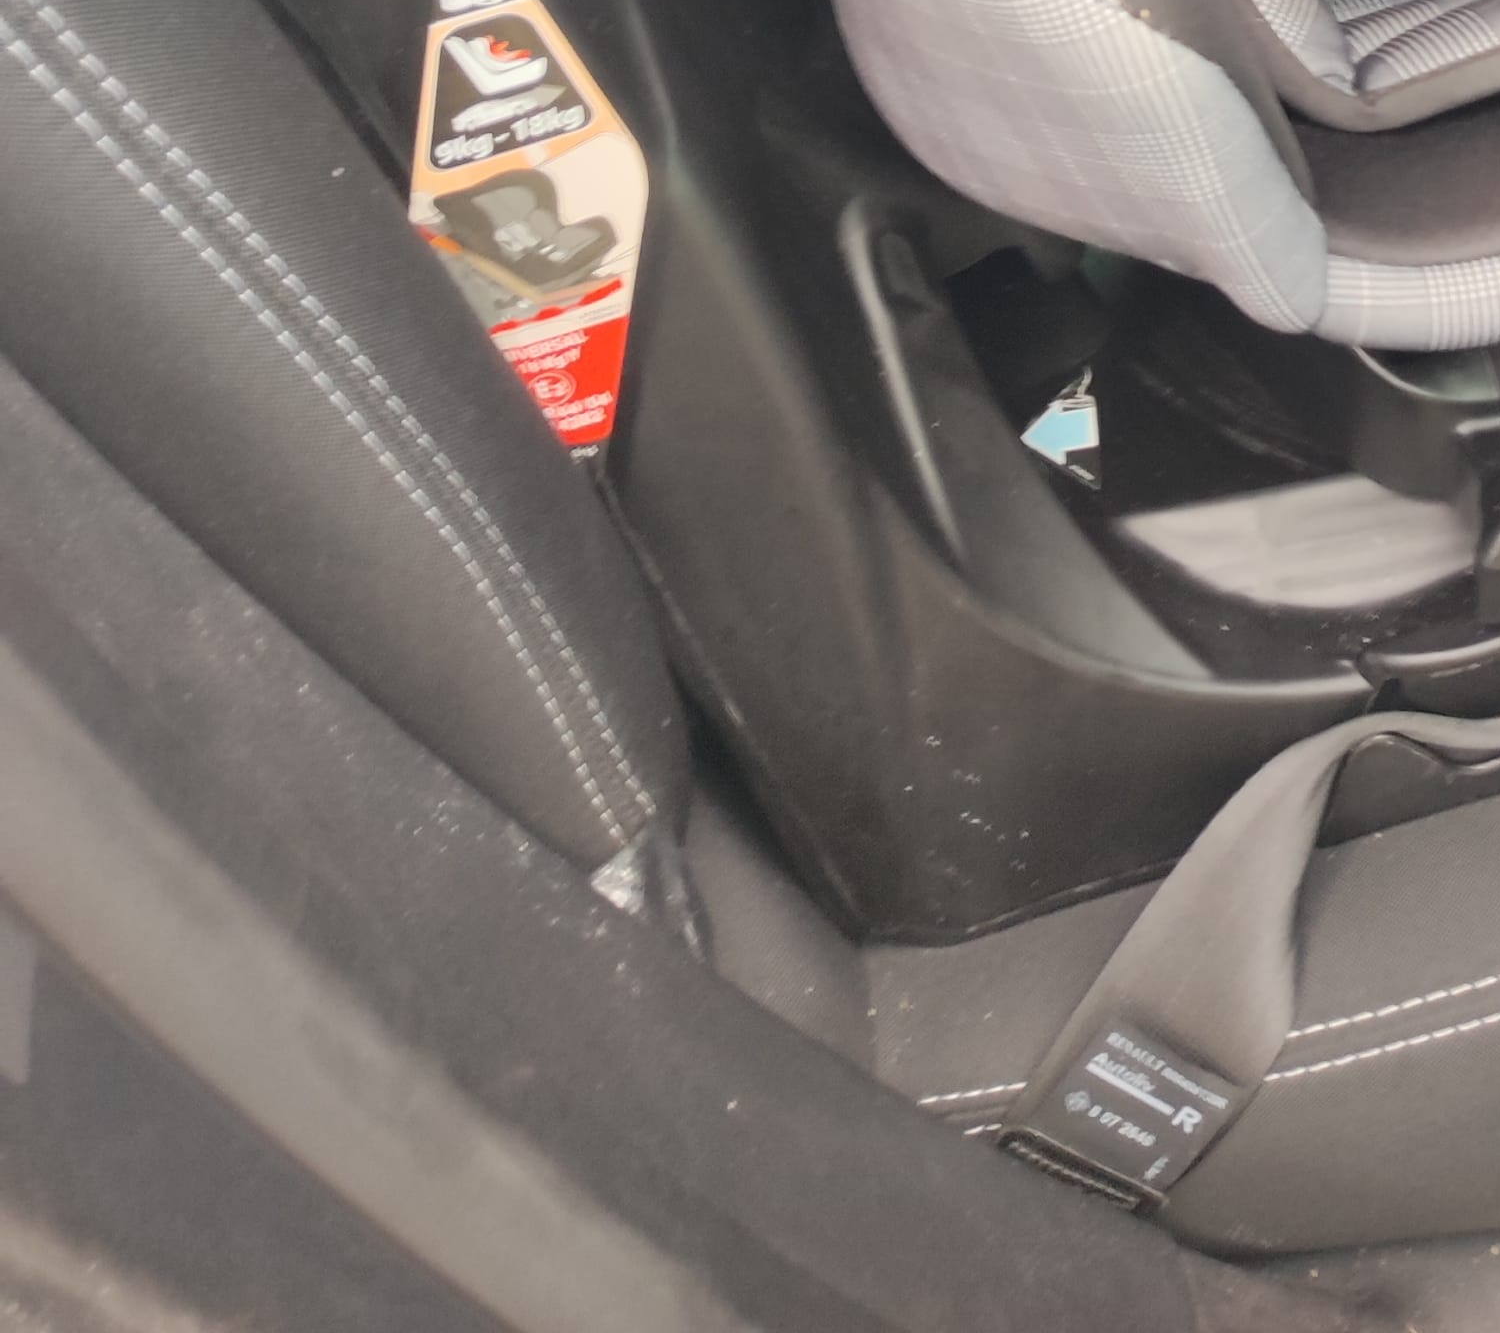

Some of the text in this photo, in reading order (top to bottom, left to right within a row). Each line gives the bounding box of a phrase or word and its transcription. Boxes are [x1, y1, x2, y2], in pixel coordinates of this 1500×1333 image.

[434, 133, 495, 166] 9kg
[510, 104, 586, 142] 18kg
[1171, 1106, 1203, 1134] R
